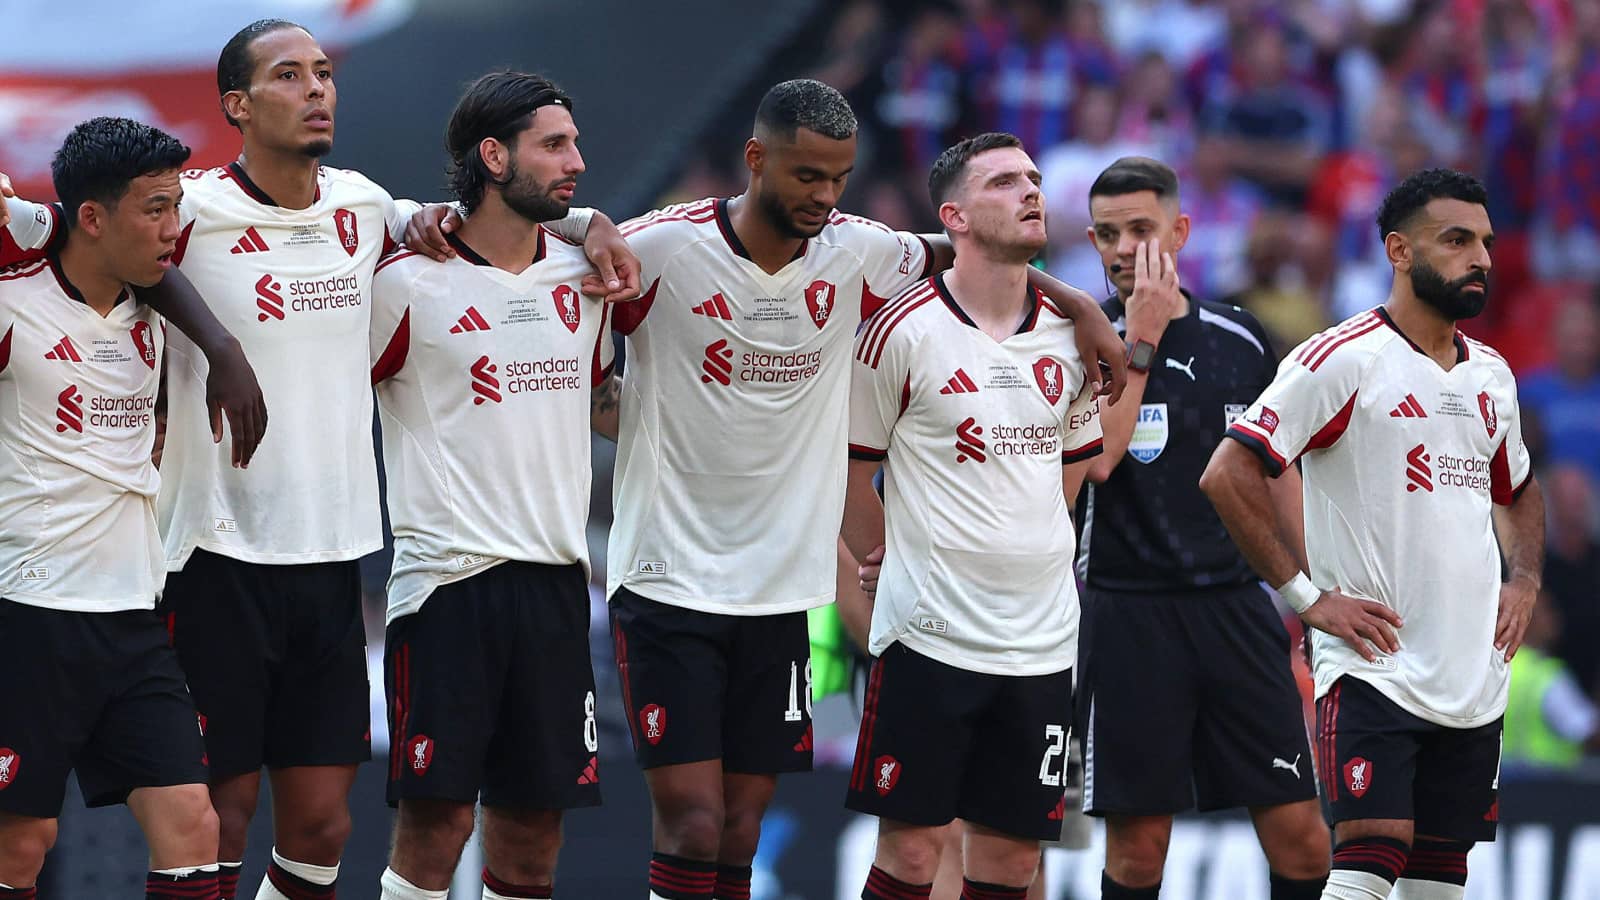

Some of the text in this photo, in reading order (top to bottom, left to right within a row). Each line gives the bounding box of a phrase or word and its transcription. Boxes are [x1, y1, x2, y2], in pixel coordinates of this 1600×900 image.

[289, 274, 358, 295] standard
[291, 291, 361, 312] chartered
[506, 356, 579, 377] standard
[742, 347, 822, 368] standard
[740, 363, 820, 383] chartered
[91, 395, 154, 411] standard
[90, 412, 150, 428] chartere
[991, 424, 1058, 440] standard
[1439, 470, 1490, 490] chartere
[584, 690, 598, 752] 8
[647, 730, 660, 738] LFC
[413, 760, 426, 769] LFC
[1038, 724, 1072, 787] 2
[877, 780, 890, 790] LFC
[1351, 782, 1365, 791] LFC
